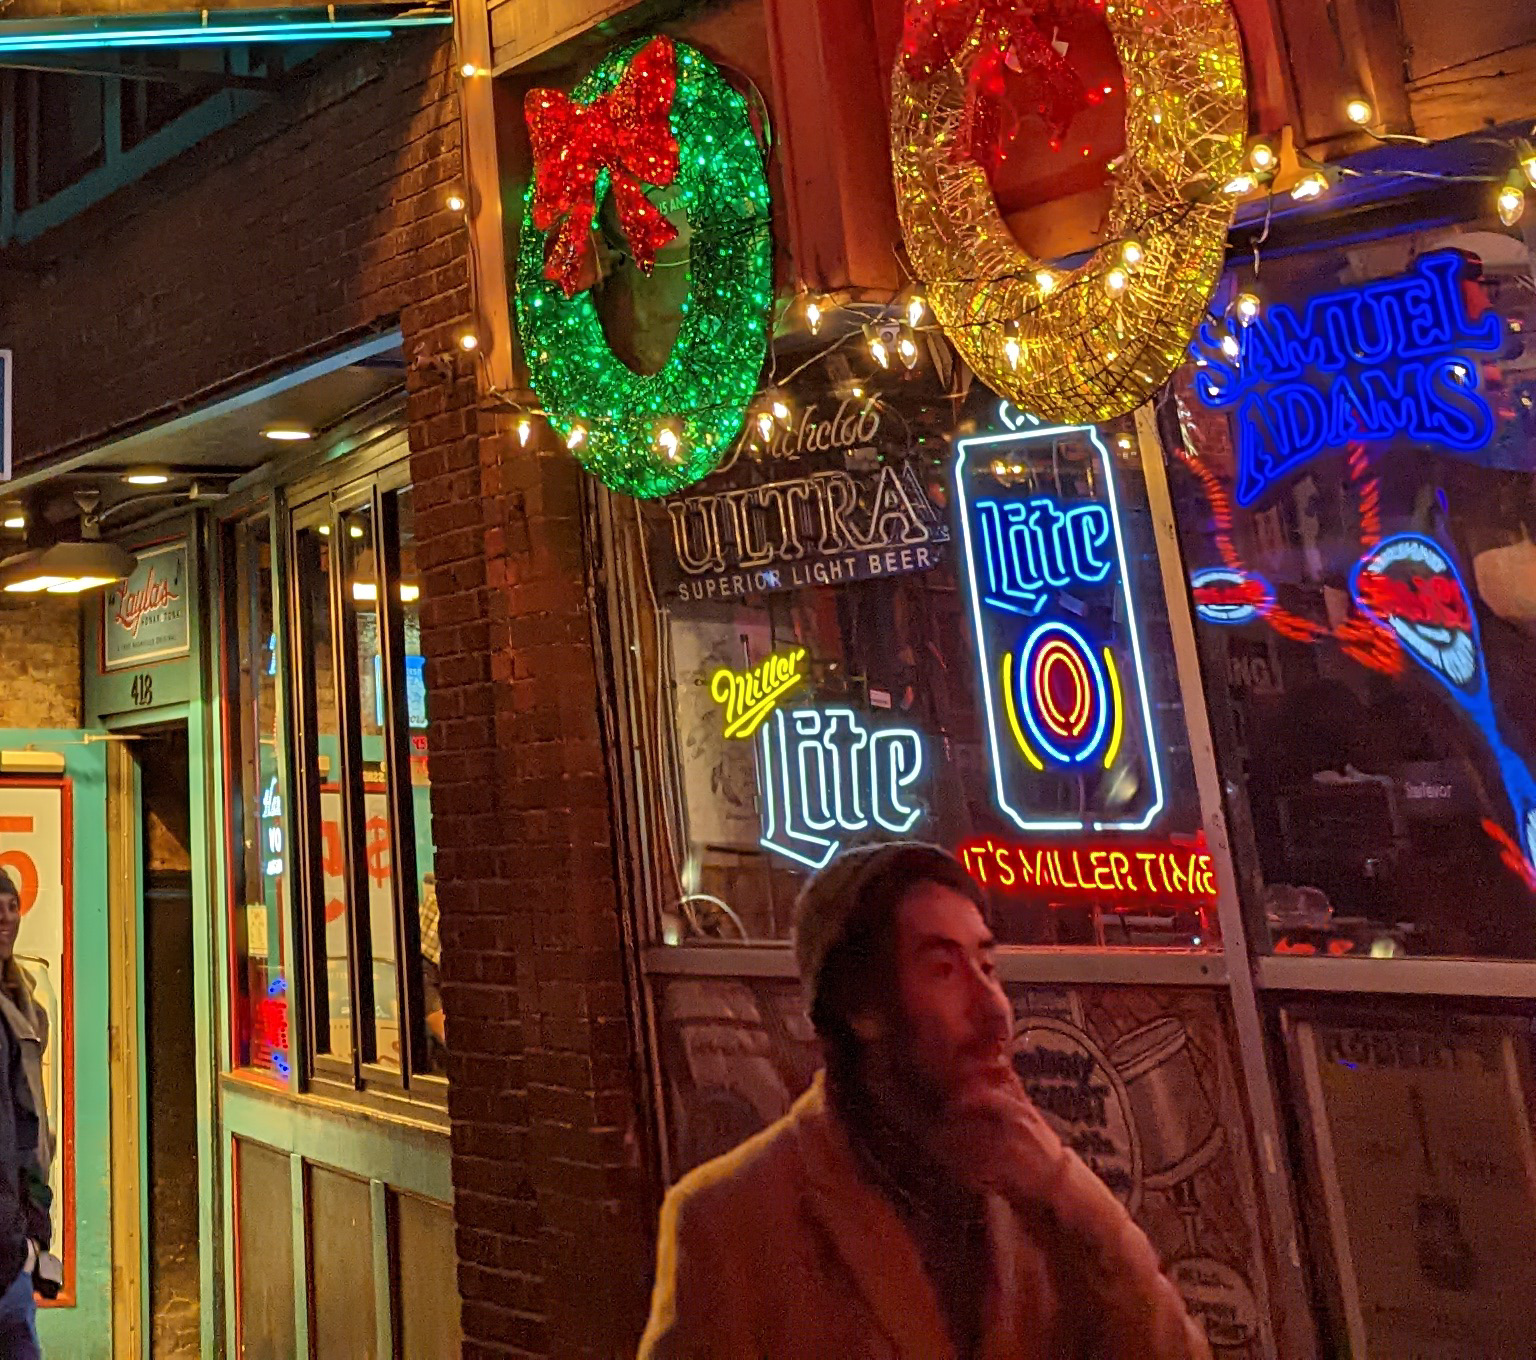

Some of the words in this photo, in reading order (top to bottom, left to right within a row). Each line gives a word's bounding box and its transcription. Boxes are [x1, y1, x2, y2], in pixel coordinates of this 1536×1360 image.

[1189, 253, 1501, 406] SAMUEL
[1237, 356, 1494, 508] ADAMS
[667, 464, 932, 575] ULTRA
[678, 567, 782, 603] SUPERIOR
[792, 558, 857, 585] LIGHT
[868, 547, 931, 575] BEER
[975, 500, 1111, 615] Lite
[130, 673, 153, 706] 418
[711, 648, 806, 726] Miller
[760, 707, 923, 870] Lite
[963, 840, 1015, 886] IT'S
[1018, 849, 1137, 892] MILLER
[1136, 853, 1217, 894] TIME
